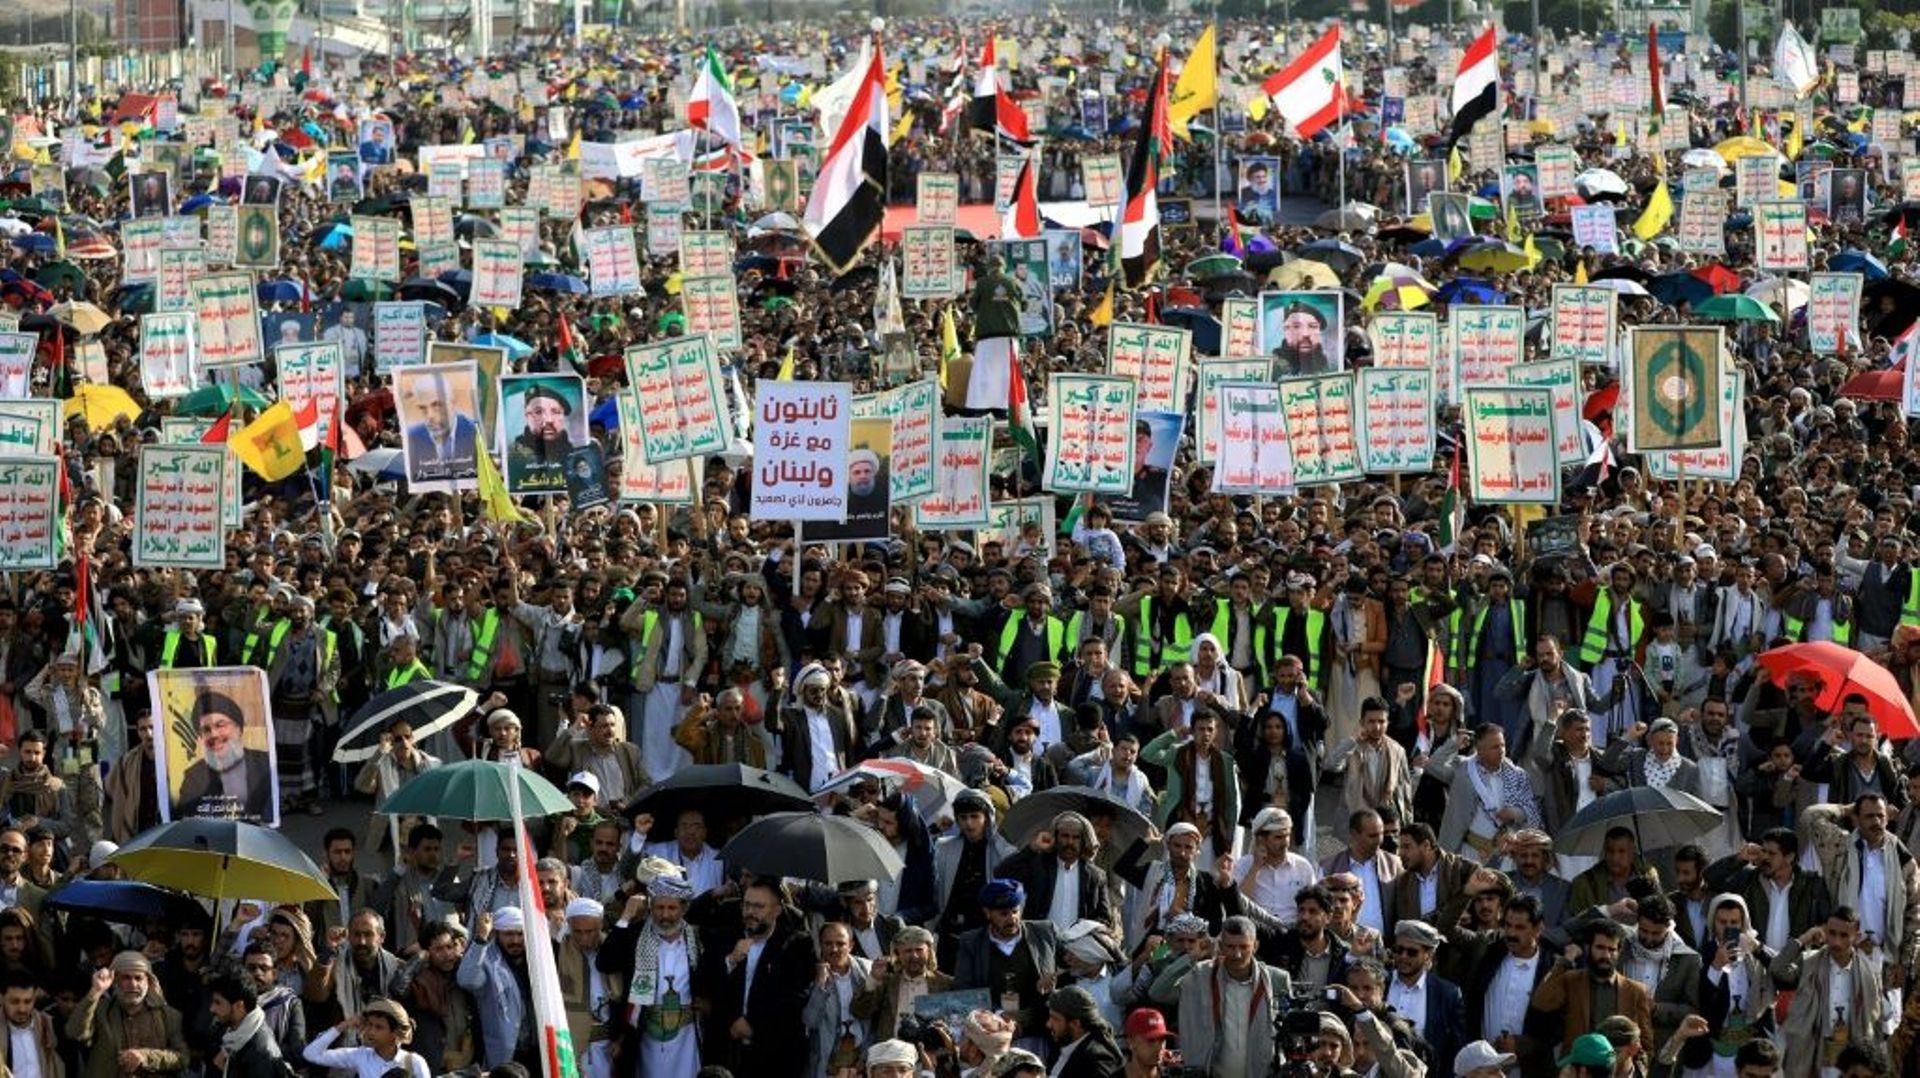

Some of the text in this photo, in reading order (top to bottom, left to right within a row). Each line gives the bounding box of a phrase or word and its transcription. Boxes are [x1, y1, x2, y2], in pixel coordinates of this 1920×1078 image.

[678, 347, 704, 365] الله
[1105, 389, 1130, 404] الله
[763, 394, 838, 426] ثابتون
[1474, 398, 1547, 420] قاطعوا
[770, 430, 831, 451] مع غزة
[192, 458, 219, 475] الله
[762, 460, 833, 488] ولبنان
